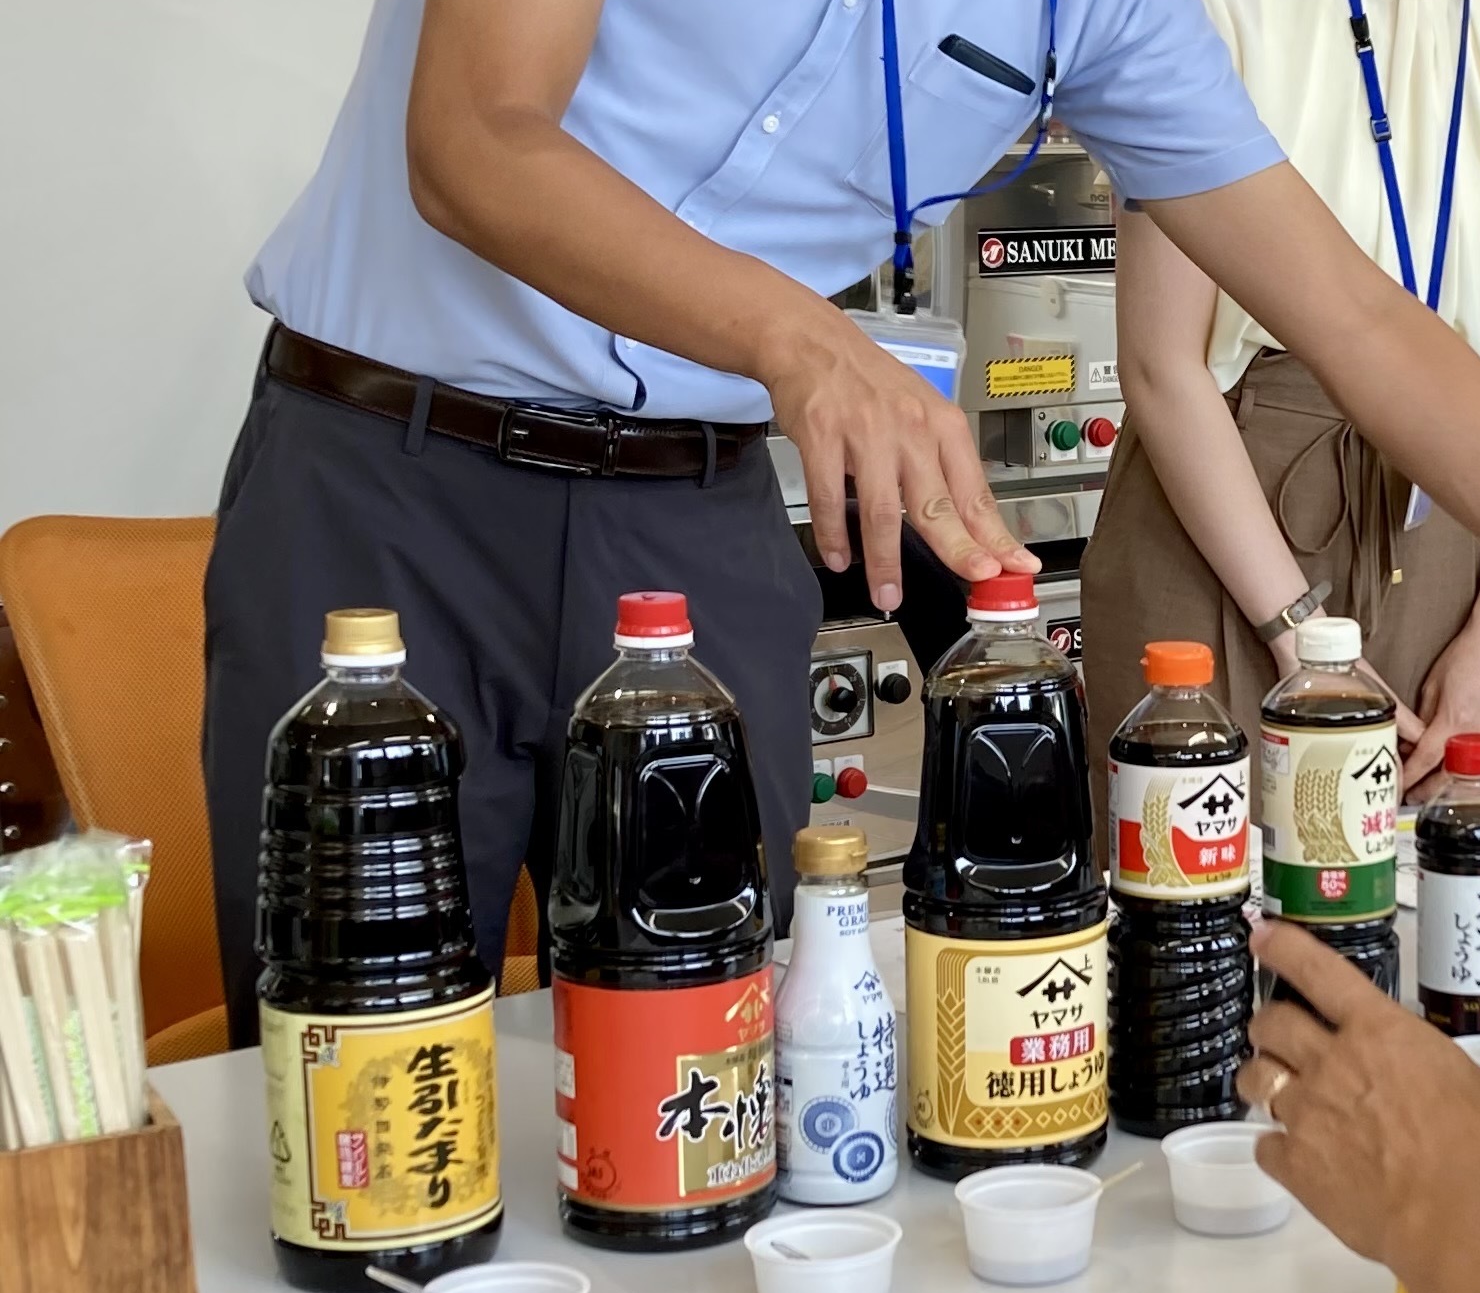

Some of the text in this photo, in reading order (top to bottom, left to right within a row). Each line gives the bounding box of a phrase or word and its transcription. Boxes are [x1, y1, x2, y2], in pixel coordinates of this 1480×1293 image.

[1007, 239, 1084, 263] SANUKI
[1195, 817, 1237, 836] ヤマサ
[1199, 844, 1236, 867] 新味
[1451, 913, 1472, 984] しょうゆ
[1030, 1003, 1084, 1029] ヤマサ
[850, 1021, 870, 1100] しょうゆ
[872, 1012, 896, 1092] 特選
[1021, 1032, 1091, 1064] 業務用
[986, 1051, 1105, 1100] 徳用しょうゆ
[406, 1043, 464, 1208] 生引たまり
